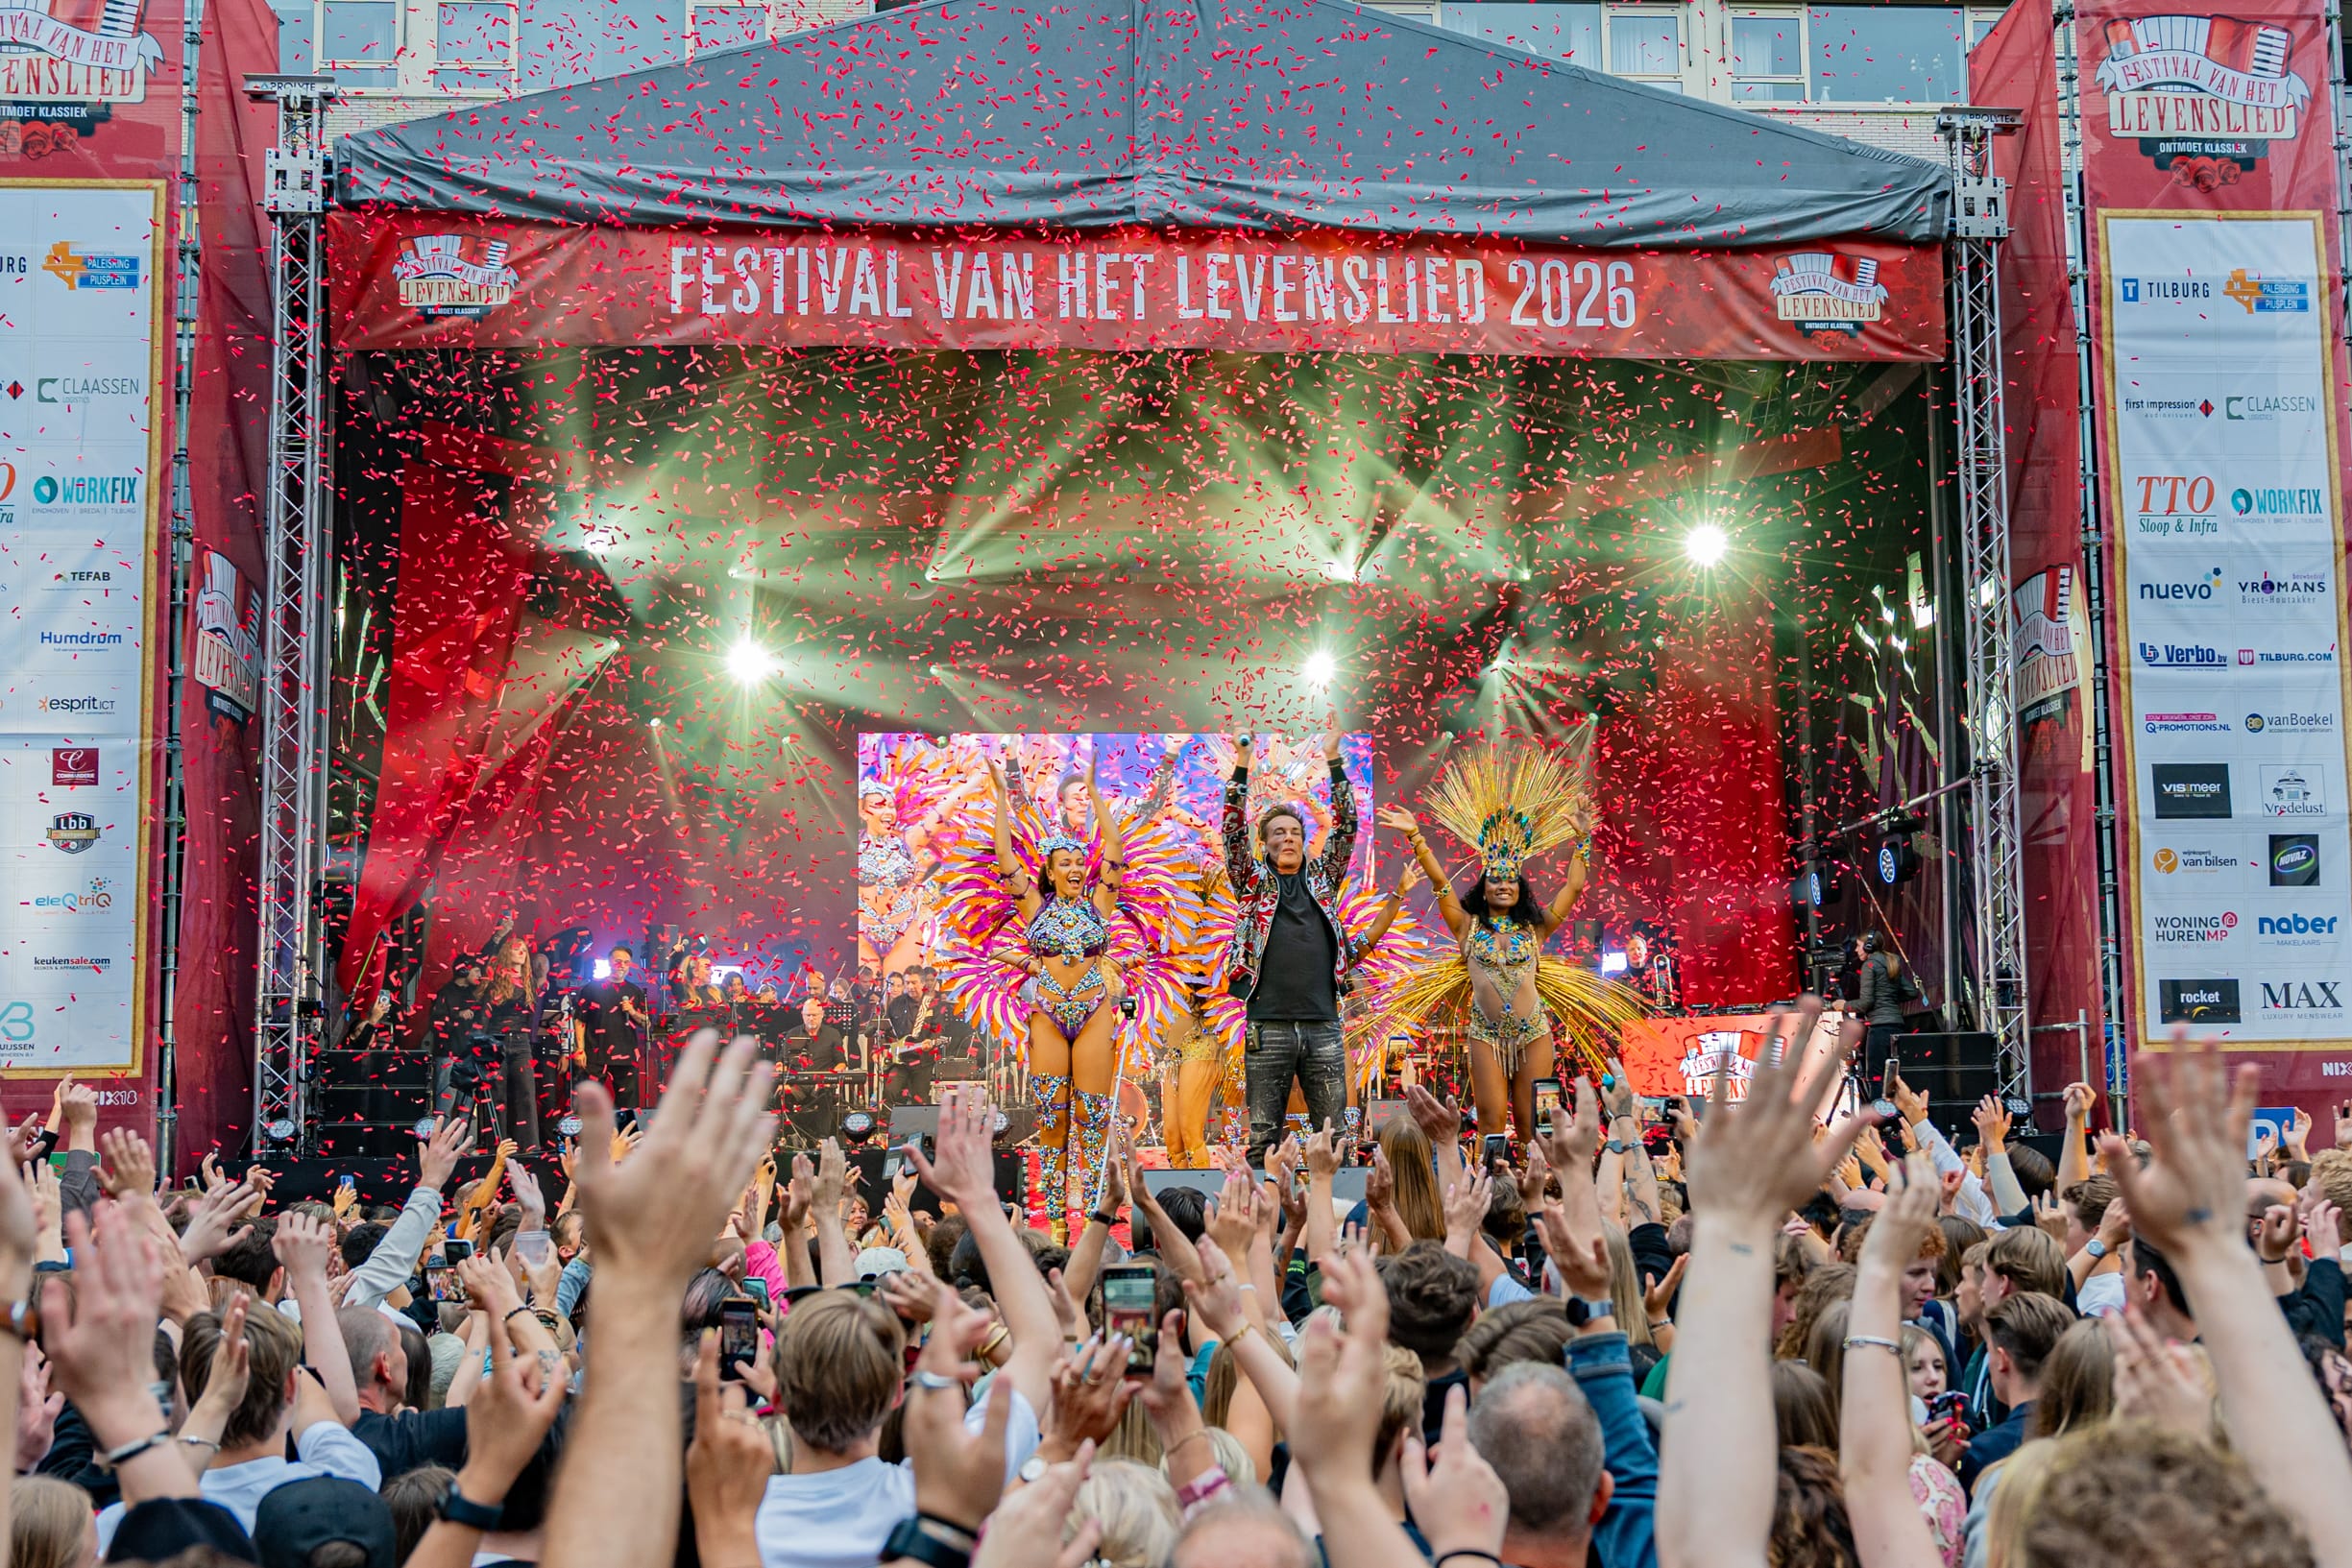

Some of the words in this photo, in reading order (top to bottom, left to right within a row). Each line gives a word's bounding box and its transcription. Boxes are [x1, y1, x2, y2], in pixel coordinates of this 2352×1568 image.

[48, 27, 85, 58] VAN
[90, 40, 128, 65] HET
[2122, 56, 2201, 86] FESTIVAL
[2209, 67, 2239, 98] VAN
[2245, 80, 2277, 103] HET
[0, 106, 36, 117] TMOET
[38, 107, 87, 117] KLASSIEK
[2120, 97, 2286, 133] LEVENSLIED
[2160, 142, 2202, 153] ONTMOET
[2205, 143, 2246, 154] KLASSIEK
[89, 275, 127, 285] PIUSPLEIN
[480, 272, 499, 285] HET
[405, 282, 504, 303] LEVENSLIED
[670, 247, 912, 318] FESTIVAL
[932, 251, 1034, 320] VAN
[1057, 252, 1156, 321] HET
[1176, 253, 1486, 325] LEVENSLIED
[1508, 258, 1636, 328] 2026
[1783, 275, 1829, 292] FESTIVAL
[1832, 281, 1850, 300] VAN
[1853, 289, 1871, 302] HET
[2147, 282, 2209, 298] TILBURG
[2263, 283, 2299, 294] PALEISRING
[1782, 298, 1876, 318] LEVENSLIED
[2266, 300, 2297, 309] PIUSPLEIN
[62, 378, 138, 394] CLAASSEN
[2125, 398, 2144, 412] first
[2146, 398, 2195, 412] impression
[2247, 397, 2315, 412] CLAASSEN
[62, 476, 137, 504] WORKFIX
[2137, 476, 2215, 513] TTO
[2255, 489, 2322, 514] WORKFIX
[2140, 518, 2170, 536] Sloop
[2174, 519, 2184, 532] &
[2189, 518, 2218, 536] Infra
[71, 571, 110, 581] TEFAB
[2140, 584, 2212, 599] nuevo
[40, 632, 122, 644] Humdrum
[2164, 645, 2216, 663] Verbo
[2218, 654, 2227, 663] bv
[2259, 653, 2332, 662] TILBURG.COM
[49, 696, 98, 712] esprit
[100, 700, 115, 710] ICT
[2267, 713, 2333, 725] vanBoekel
[2146, 722, 2231, 734] Q-PROMOTIONS.NL
[2265, 802, 2324, 813] Vredelust
[2205, 856, 2237, 867] bilsen
[35, 892, 111, 907] eleQtriQ
[2155, 917, 2219, 929] WONING
[2259, 913, 2338, 934] naber
[2156, 930, 2228, 941] HURENMP
[34, 956, 110, 965] keukensale.com
[2180, 990, 2220, 1003] rocket
[2260, 981, 2343, 1008] MAX
[94, 1090, 137, 1105] IX18
